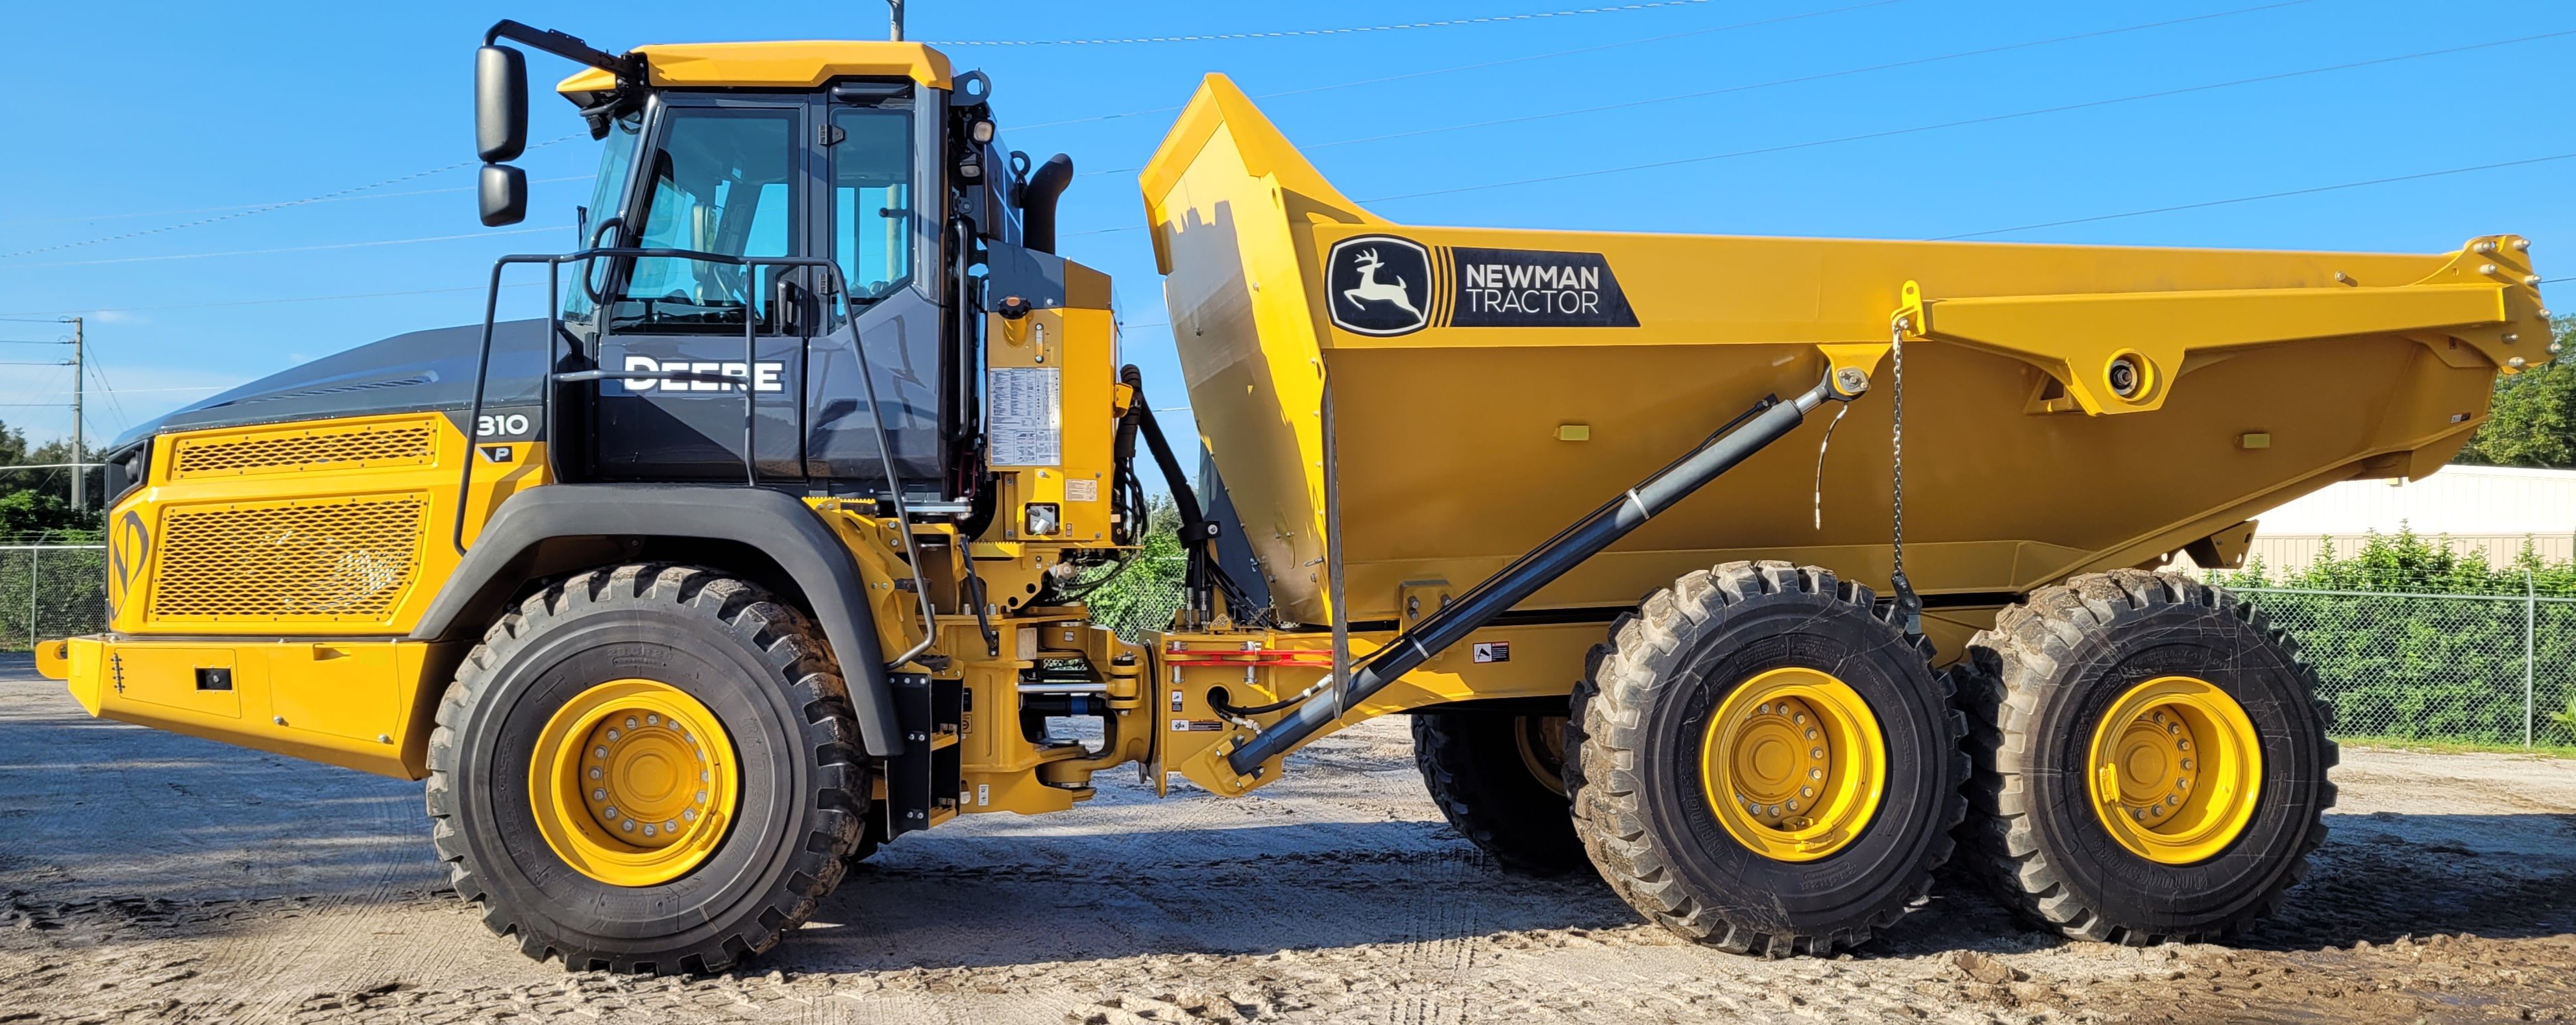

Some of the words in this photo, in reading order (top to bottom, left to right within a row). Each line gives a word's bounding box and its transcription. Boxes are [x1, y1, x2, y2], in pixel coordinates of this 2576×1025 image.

[1466, 264, 1599, 290] NEWMAN
[1466, 289, 1599, 314] TRACTOR
[624, 356, 783, 391] DEERE
[476, 414, 529, 436] 310
[494, 447, 509, 462] P
